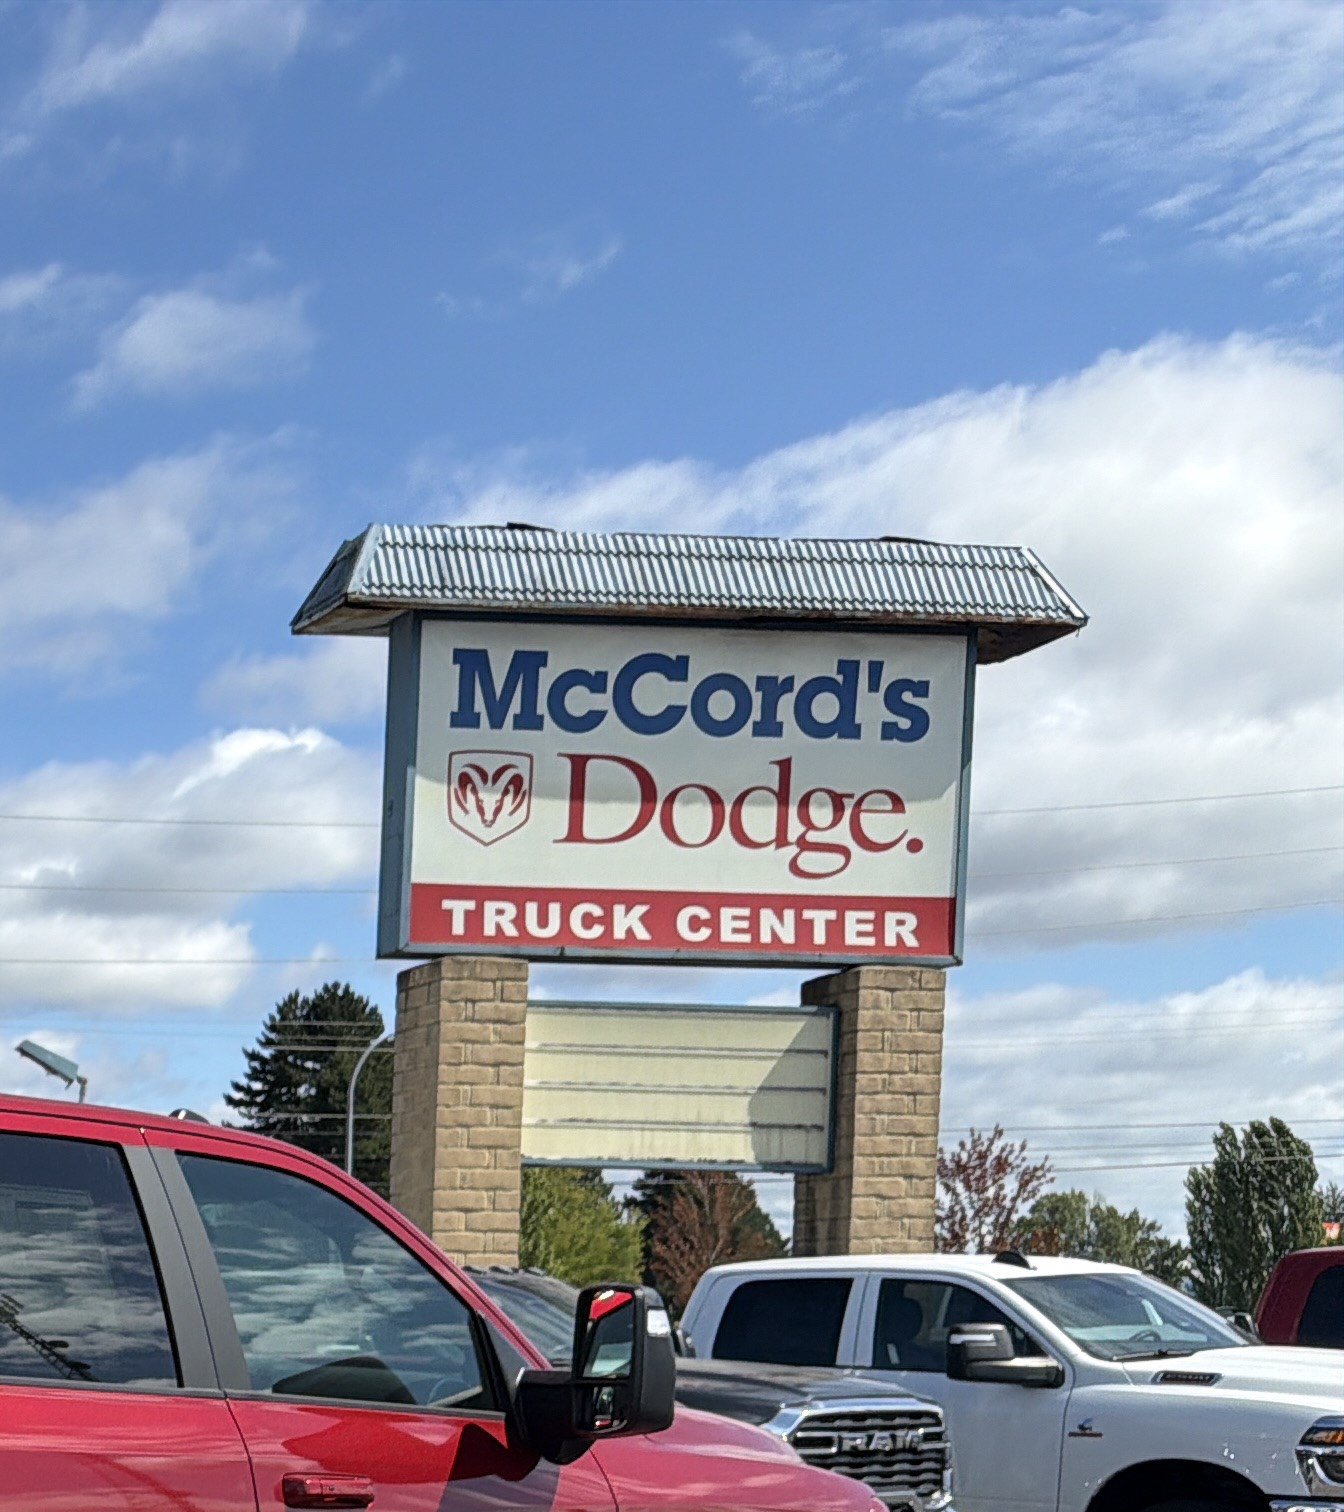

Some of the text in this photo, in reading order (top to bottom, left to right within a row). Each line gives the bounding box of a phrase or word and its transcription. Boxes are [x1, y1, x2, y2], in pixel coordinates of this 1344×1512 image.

[449, 647, 932, 743] McCord's
[441, 898, 920, 948] TRUCK CENTER
[839, 1429, 921, 1452] RAM
